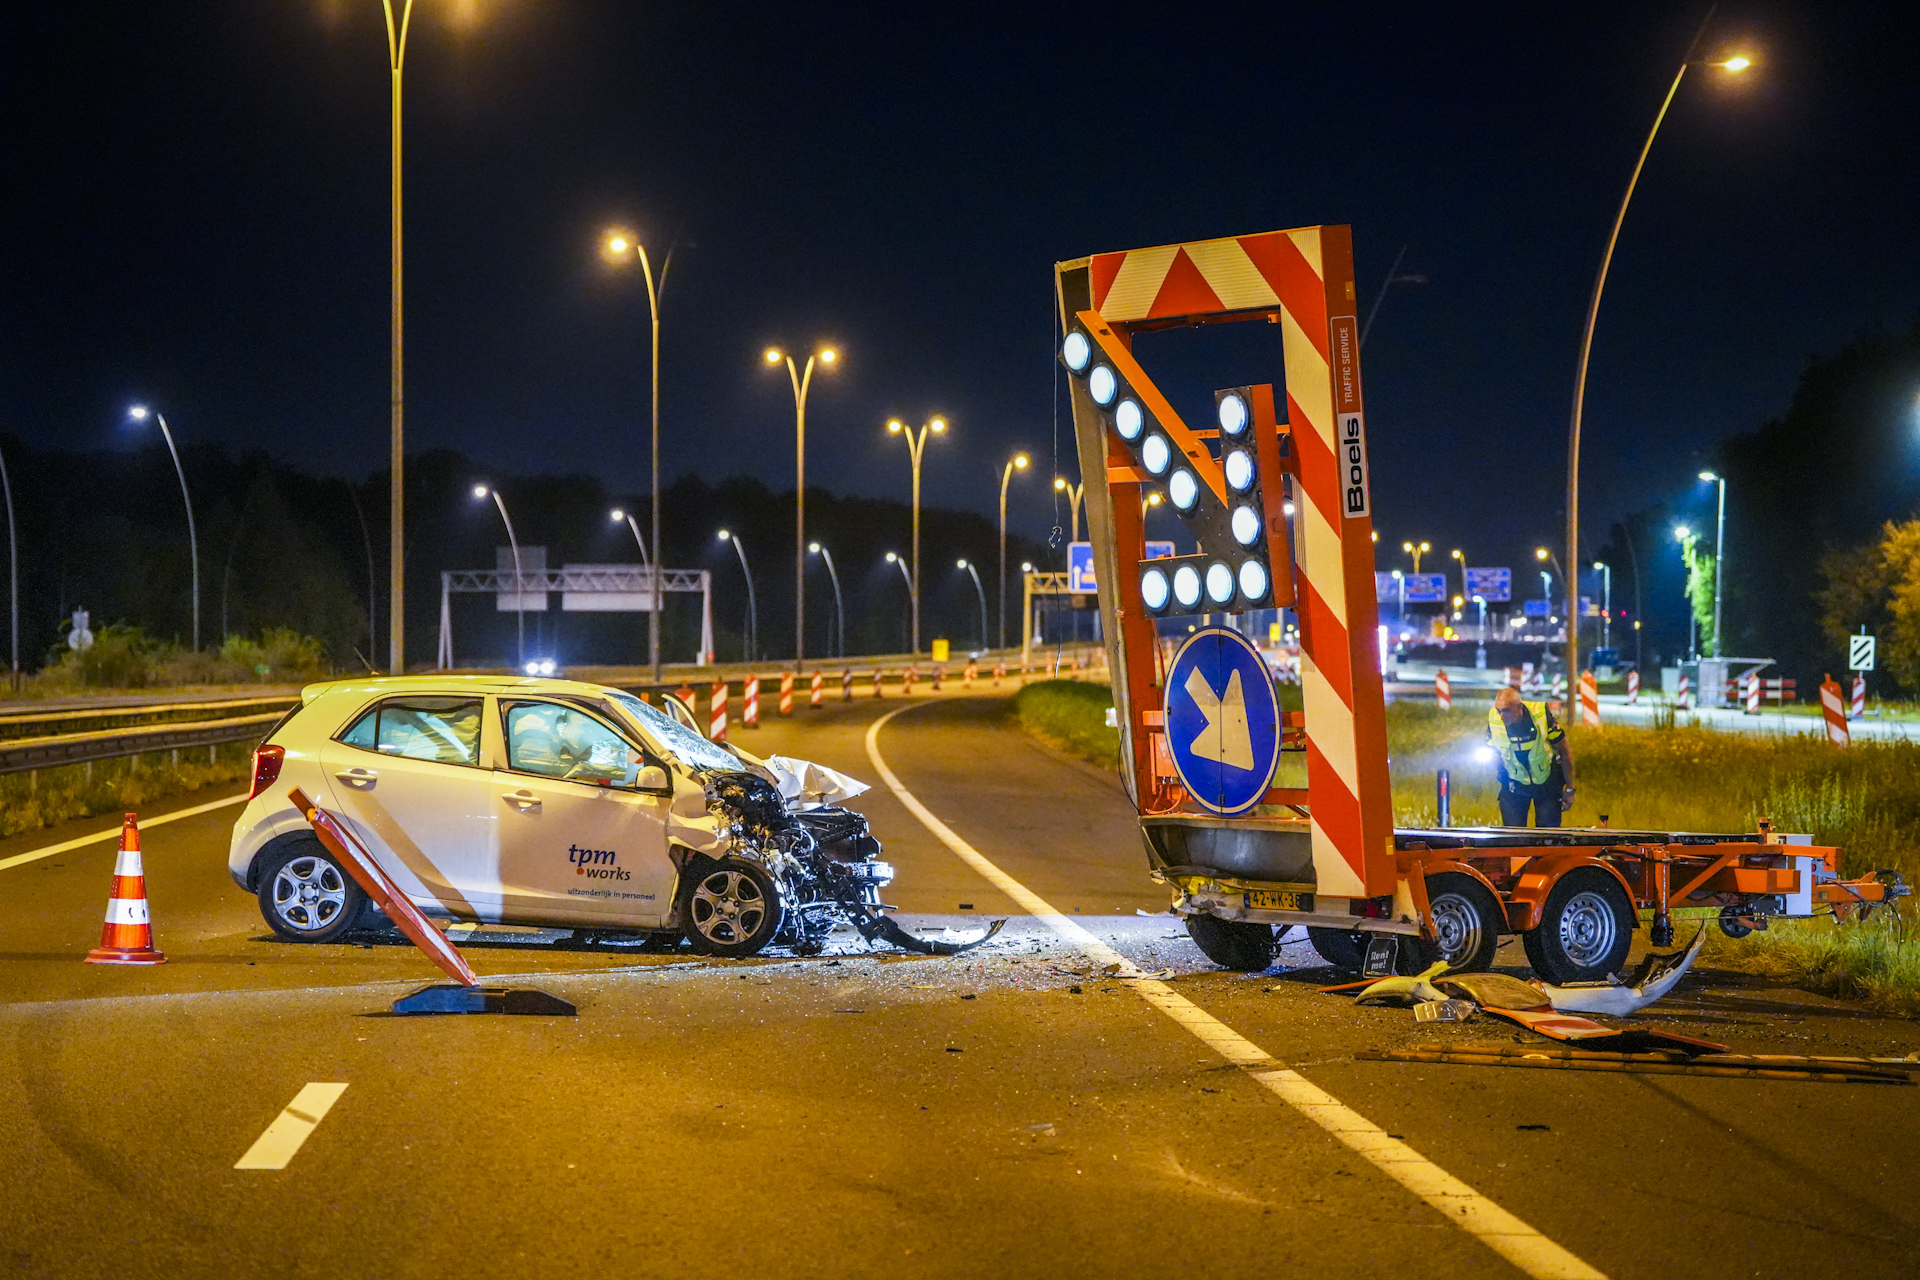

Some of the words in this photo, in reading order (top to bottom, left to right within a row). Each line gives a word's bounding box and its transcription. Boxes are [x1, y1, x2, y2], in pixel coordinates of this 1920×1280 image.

[1340, 327, 1351, 365] SERVICE
[1343, 367, 1353, 404] TRAFFIC
[1344, 418, 1364, 512] Boels
[568, 844, 616, 867] tpm
[567, 888, 612, 898] uitzonderlijk
[622, 891, 656, 900] personeel
[1371, 950, 1389, 960] Rent
[1371, 959, 1386, 970] me!
